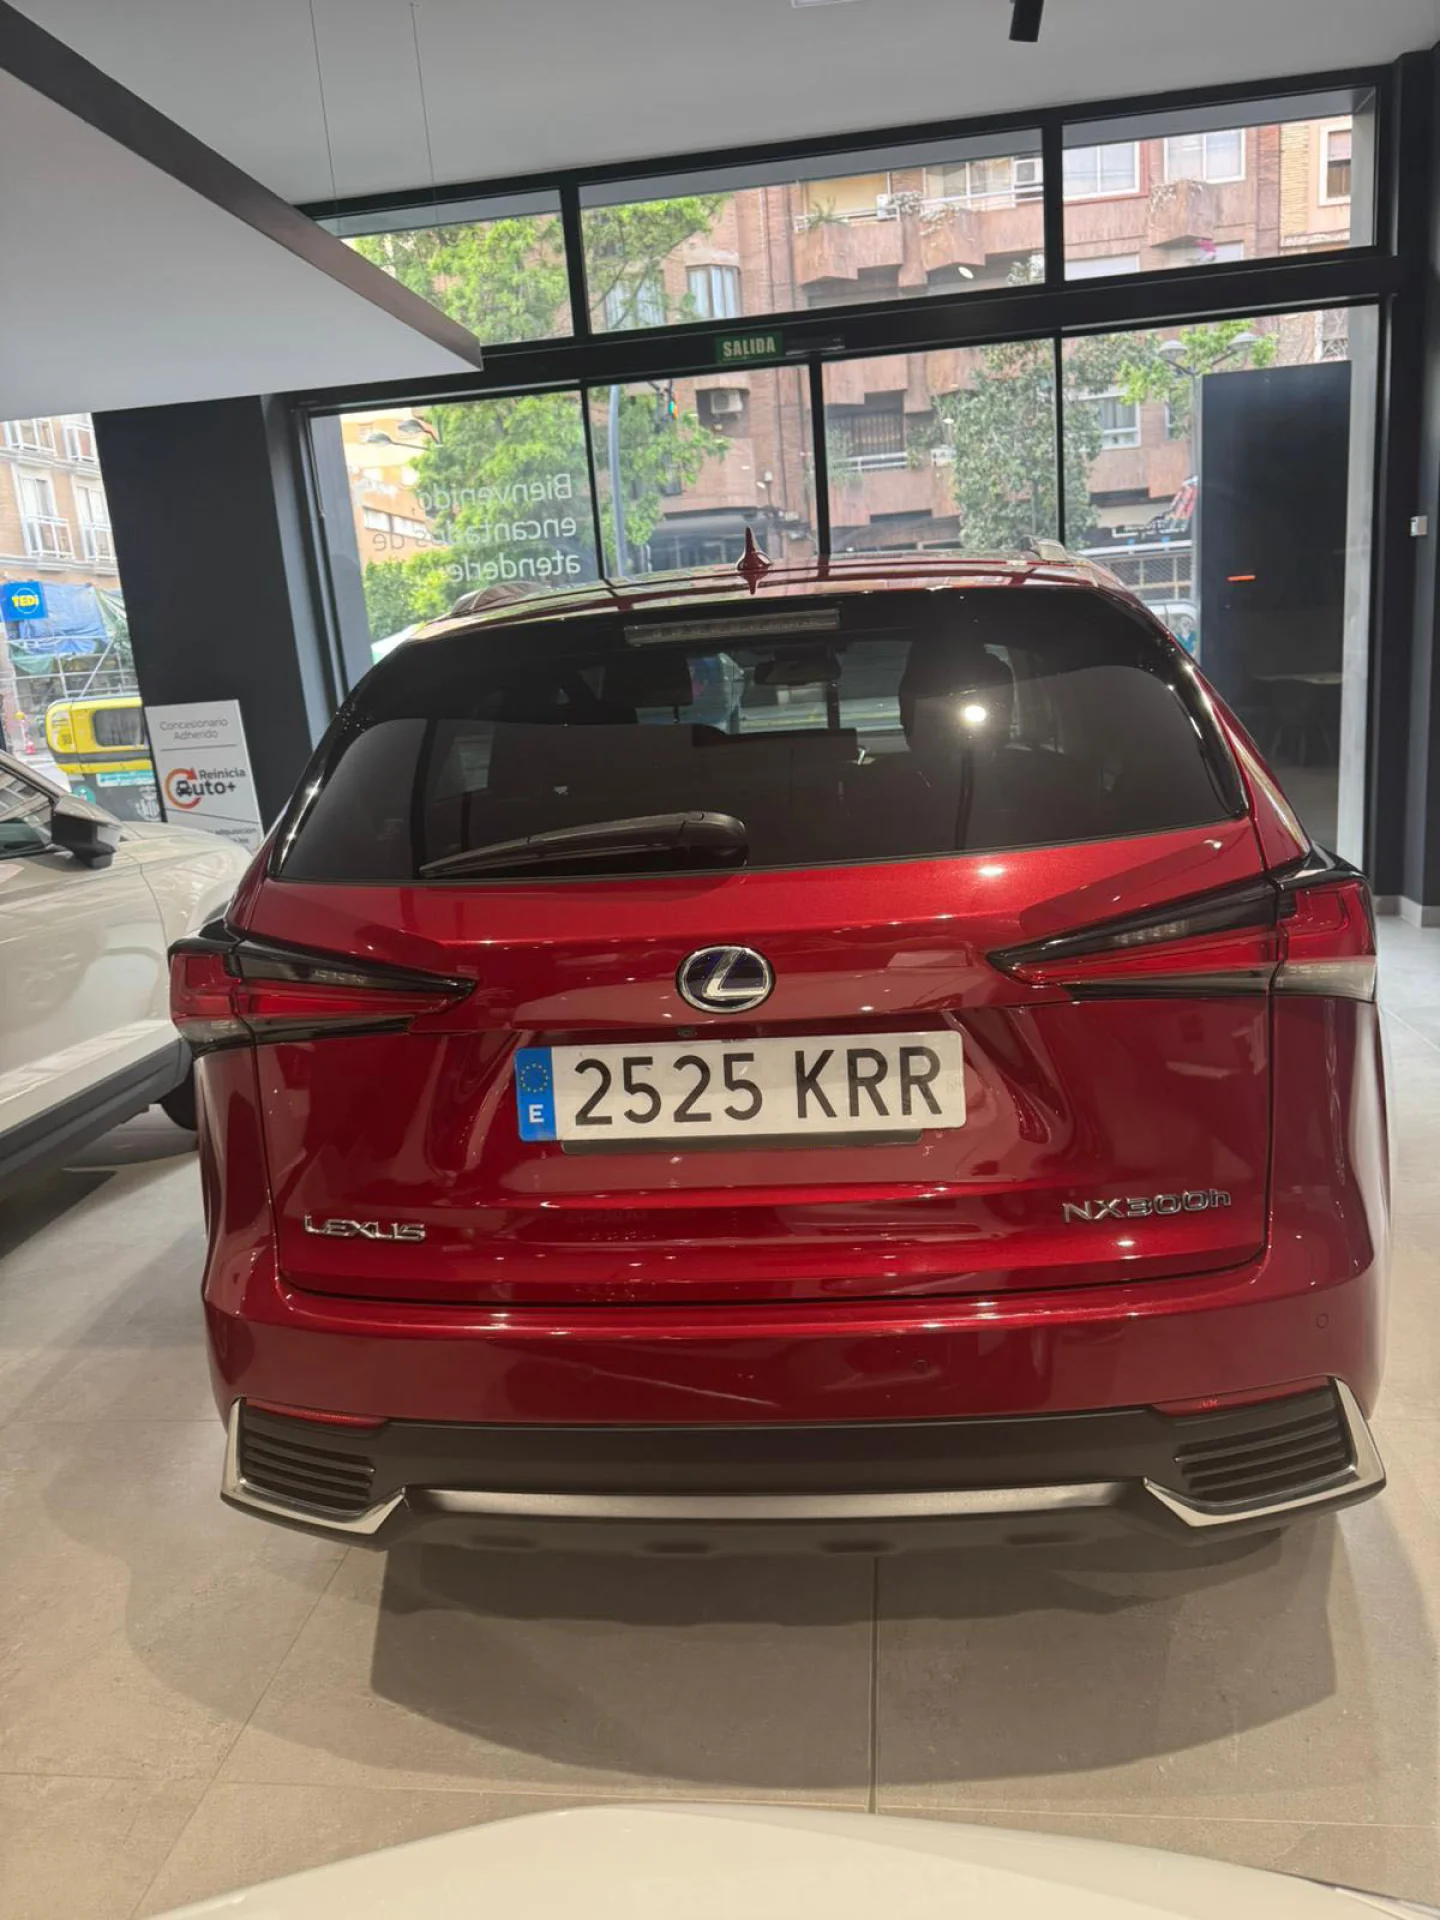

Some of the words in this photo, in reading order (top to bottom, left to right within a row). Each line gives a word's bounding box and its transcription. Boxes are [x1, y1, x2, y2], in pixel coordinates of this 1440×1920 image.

[722, 336, 776, 357] SALIDA
[199, 767, 246, 780] Reinicia
[529, 1104, 544, 1123] E
[574, 1052, 763, 1126] 2525
[794, 1045, 943, 1118] KRR
[1062, 1188, 1232, 1223] NX300h
[304, 1213, 426, 1241] LEXUS
